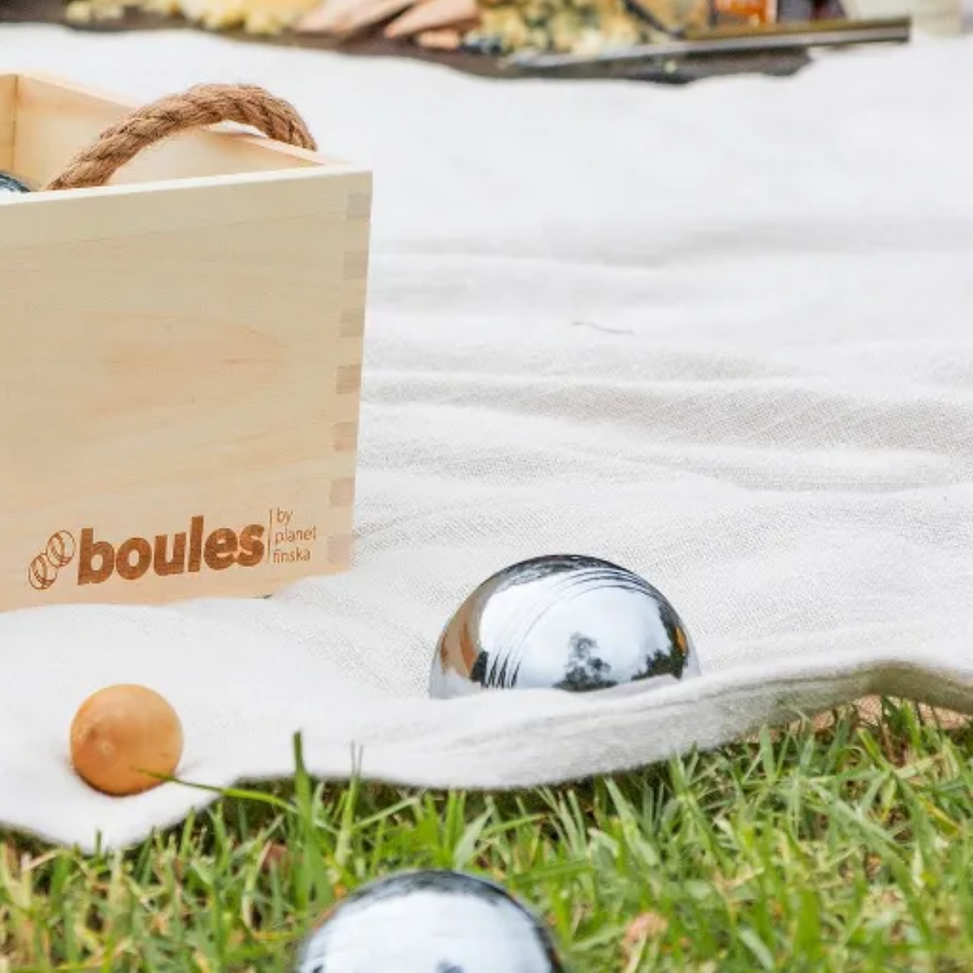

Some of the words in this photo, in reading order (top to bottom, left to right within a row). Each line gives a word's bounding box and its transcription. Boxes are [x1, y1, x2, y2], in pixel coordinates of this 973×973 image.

[276, 507, 294, 525] by
[275, 525, 317, 545] planet
[77, 515, 265, 586] boules
[273, 547, 311, 564] finska
